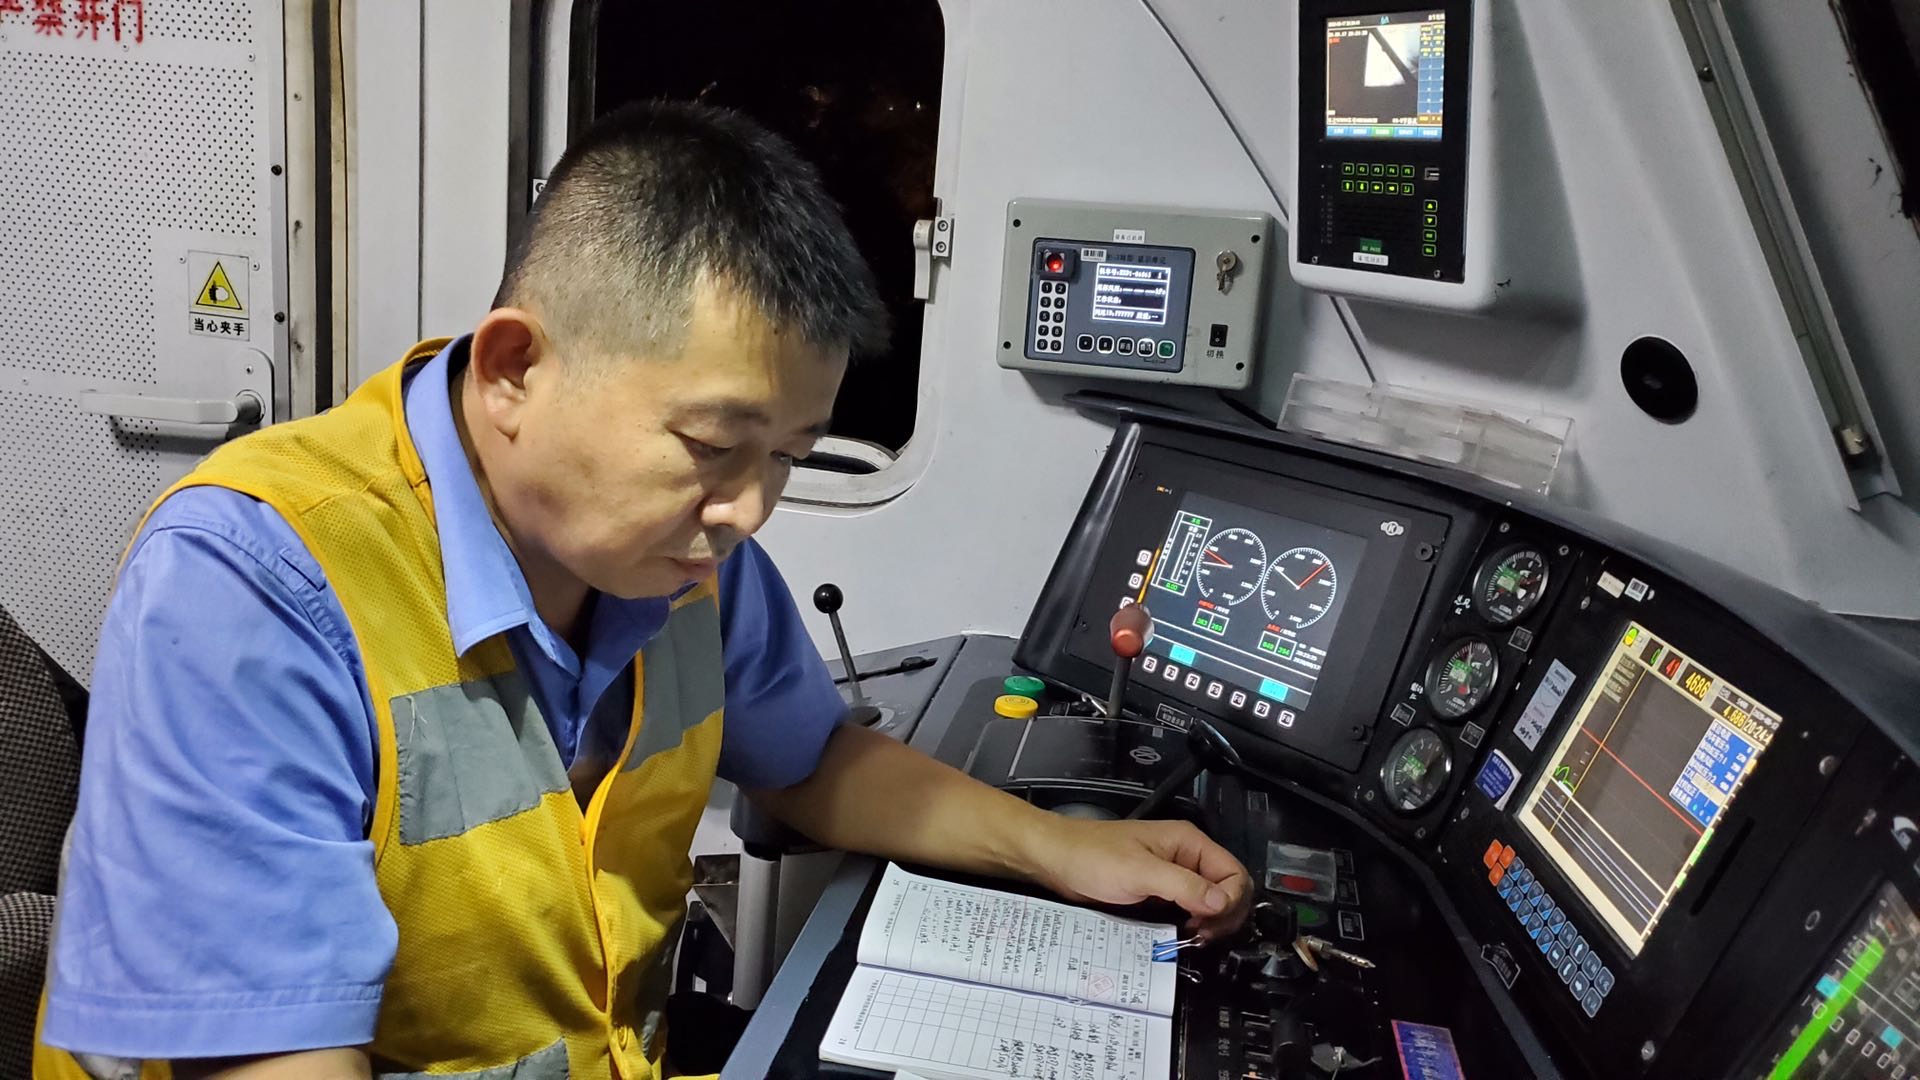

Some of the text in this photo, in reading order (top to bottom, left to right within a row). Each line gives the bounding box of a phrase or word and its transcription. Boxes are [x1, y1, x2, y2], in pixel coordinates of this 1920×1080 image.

[194, 317, 245, 336] 当心夹手
[1685, 671, 1711, 699] 4686
[1723, 705, 1747, 727] 4.686
